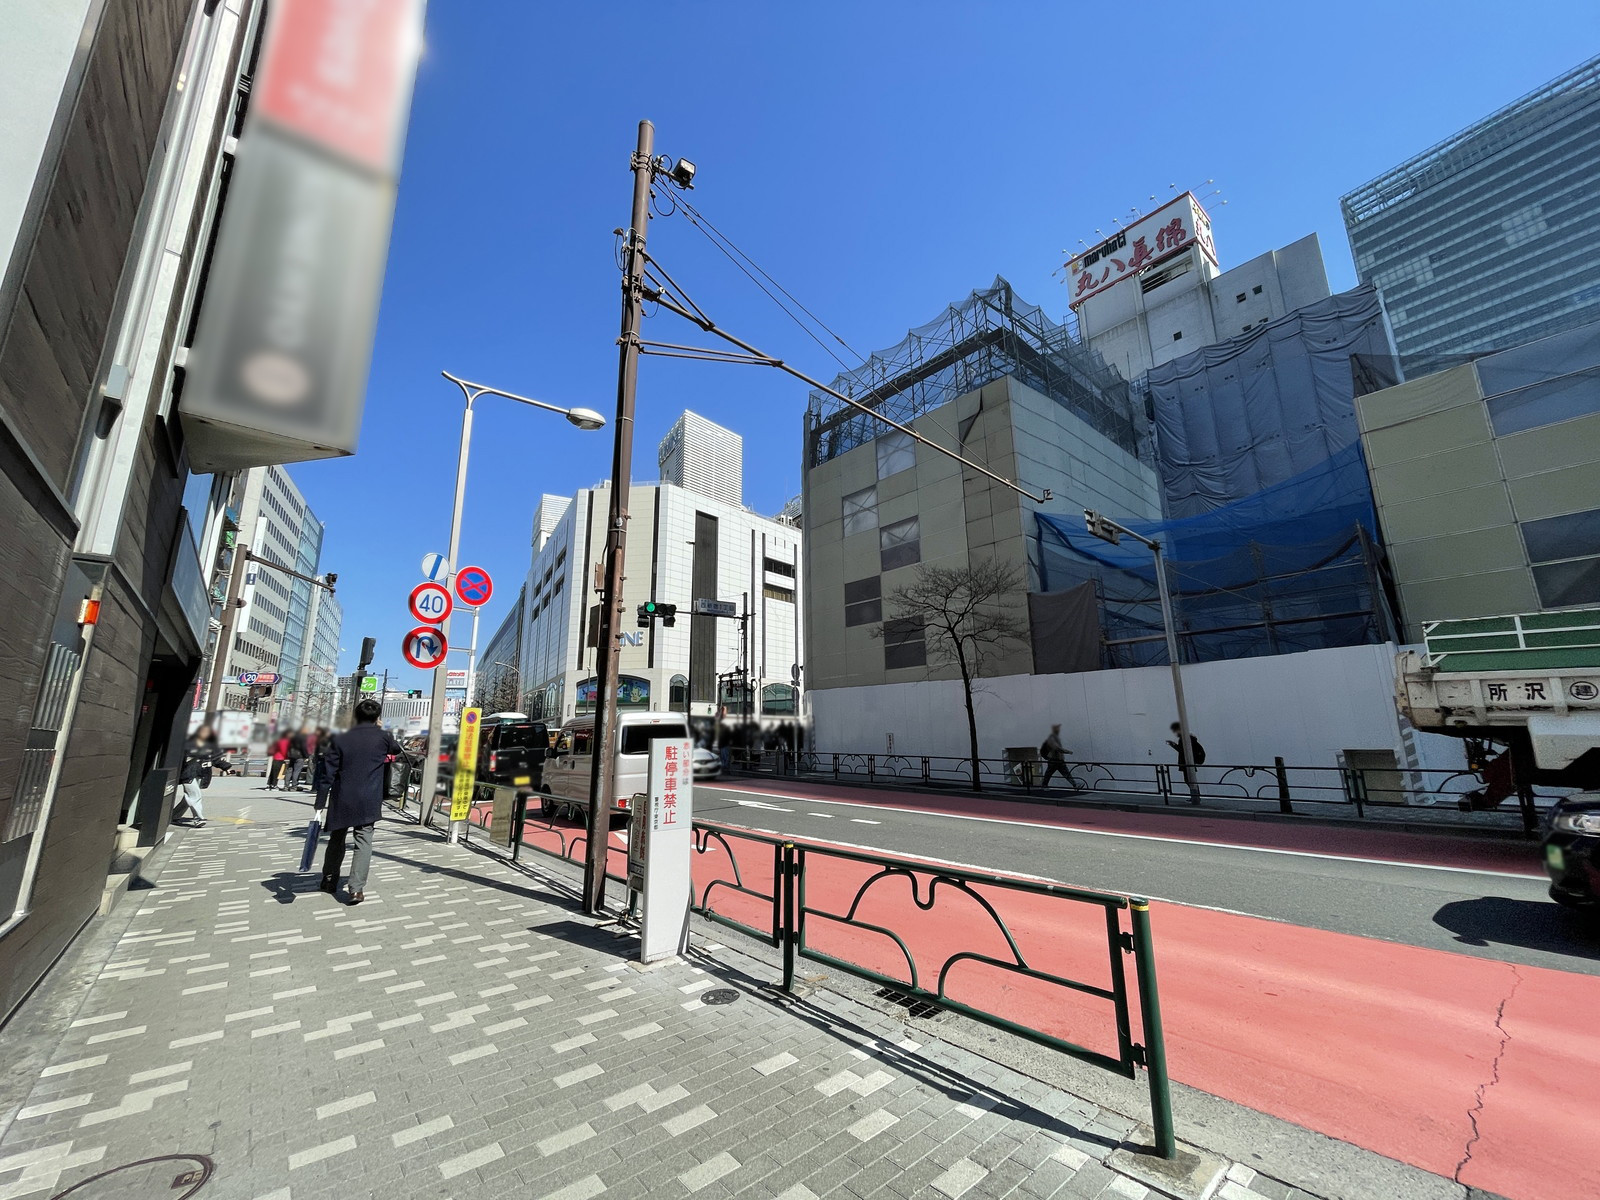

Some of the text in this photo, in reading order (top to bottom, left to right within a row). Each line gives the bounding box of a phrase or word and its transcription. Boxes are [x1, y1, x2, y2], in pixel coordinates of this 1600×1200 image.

[1083, 229, 1127, 268] maruhati
[419, 593, 443, 613] 40
[246, 674, 257, 682] 20
[1488, 682, 1546, 702] 所沢
[663, 746, 678, 825] 駐停車禁止
